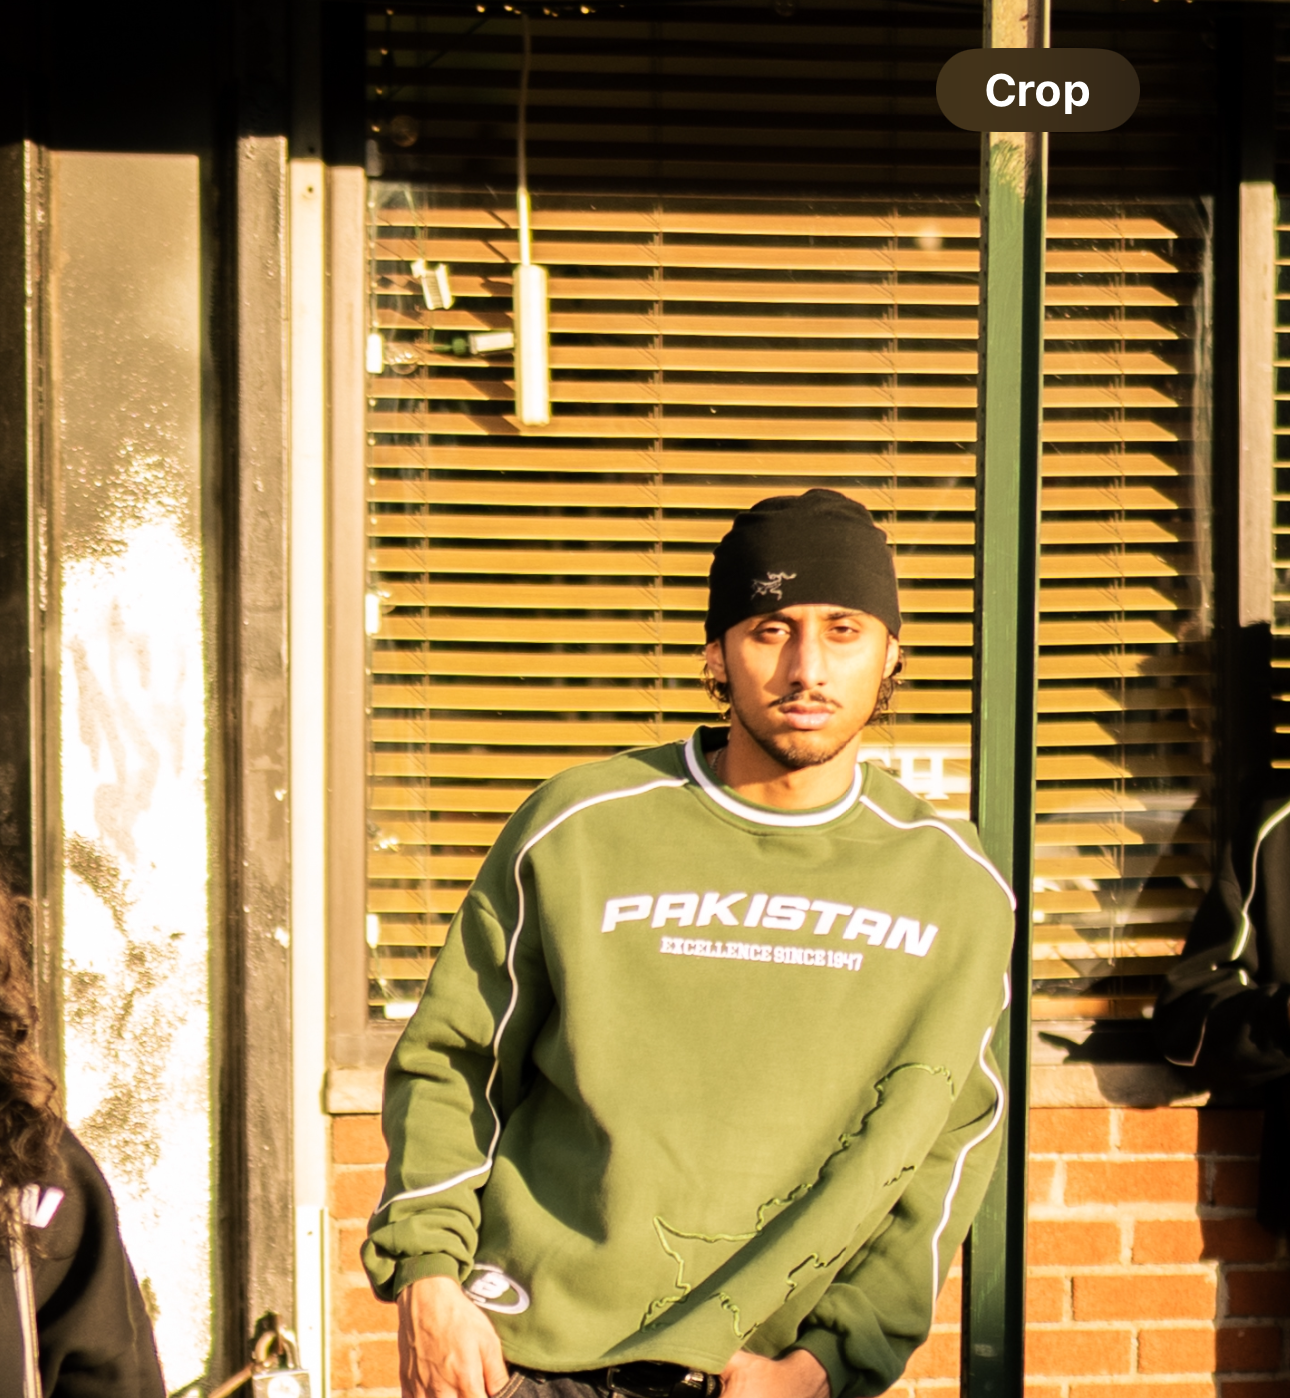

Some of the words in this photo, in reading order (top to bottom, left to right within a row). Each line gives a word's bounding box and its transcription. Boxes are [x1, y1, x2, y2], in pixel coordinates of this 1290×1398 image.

[600, 891, 939, 958] PAKISTAN
[659, 935, 773, 962] EXCELLENCE
[773, 944, 826, 967] SINCE
[826, 950, 864, 972] 1947
